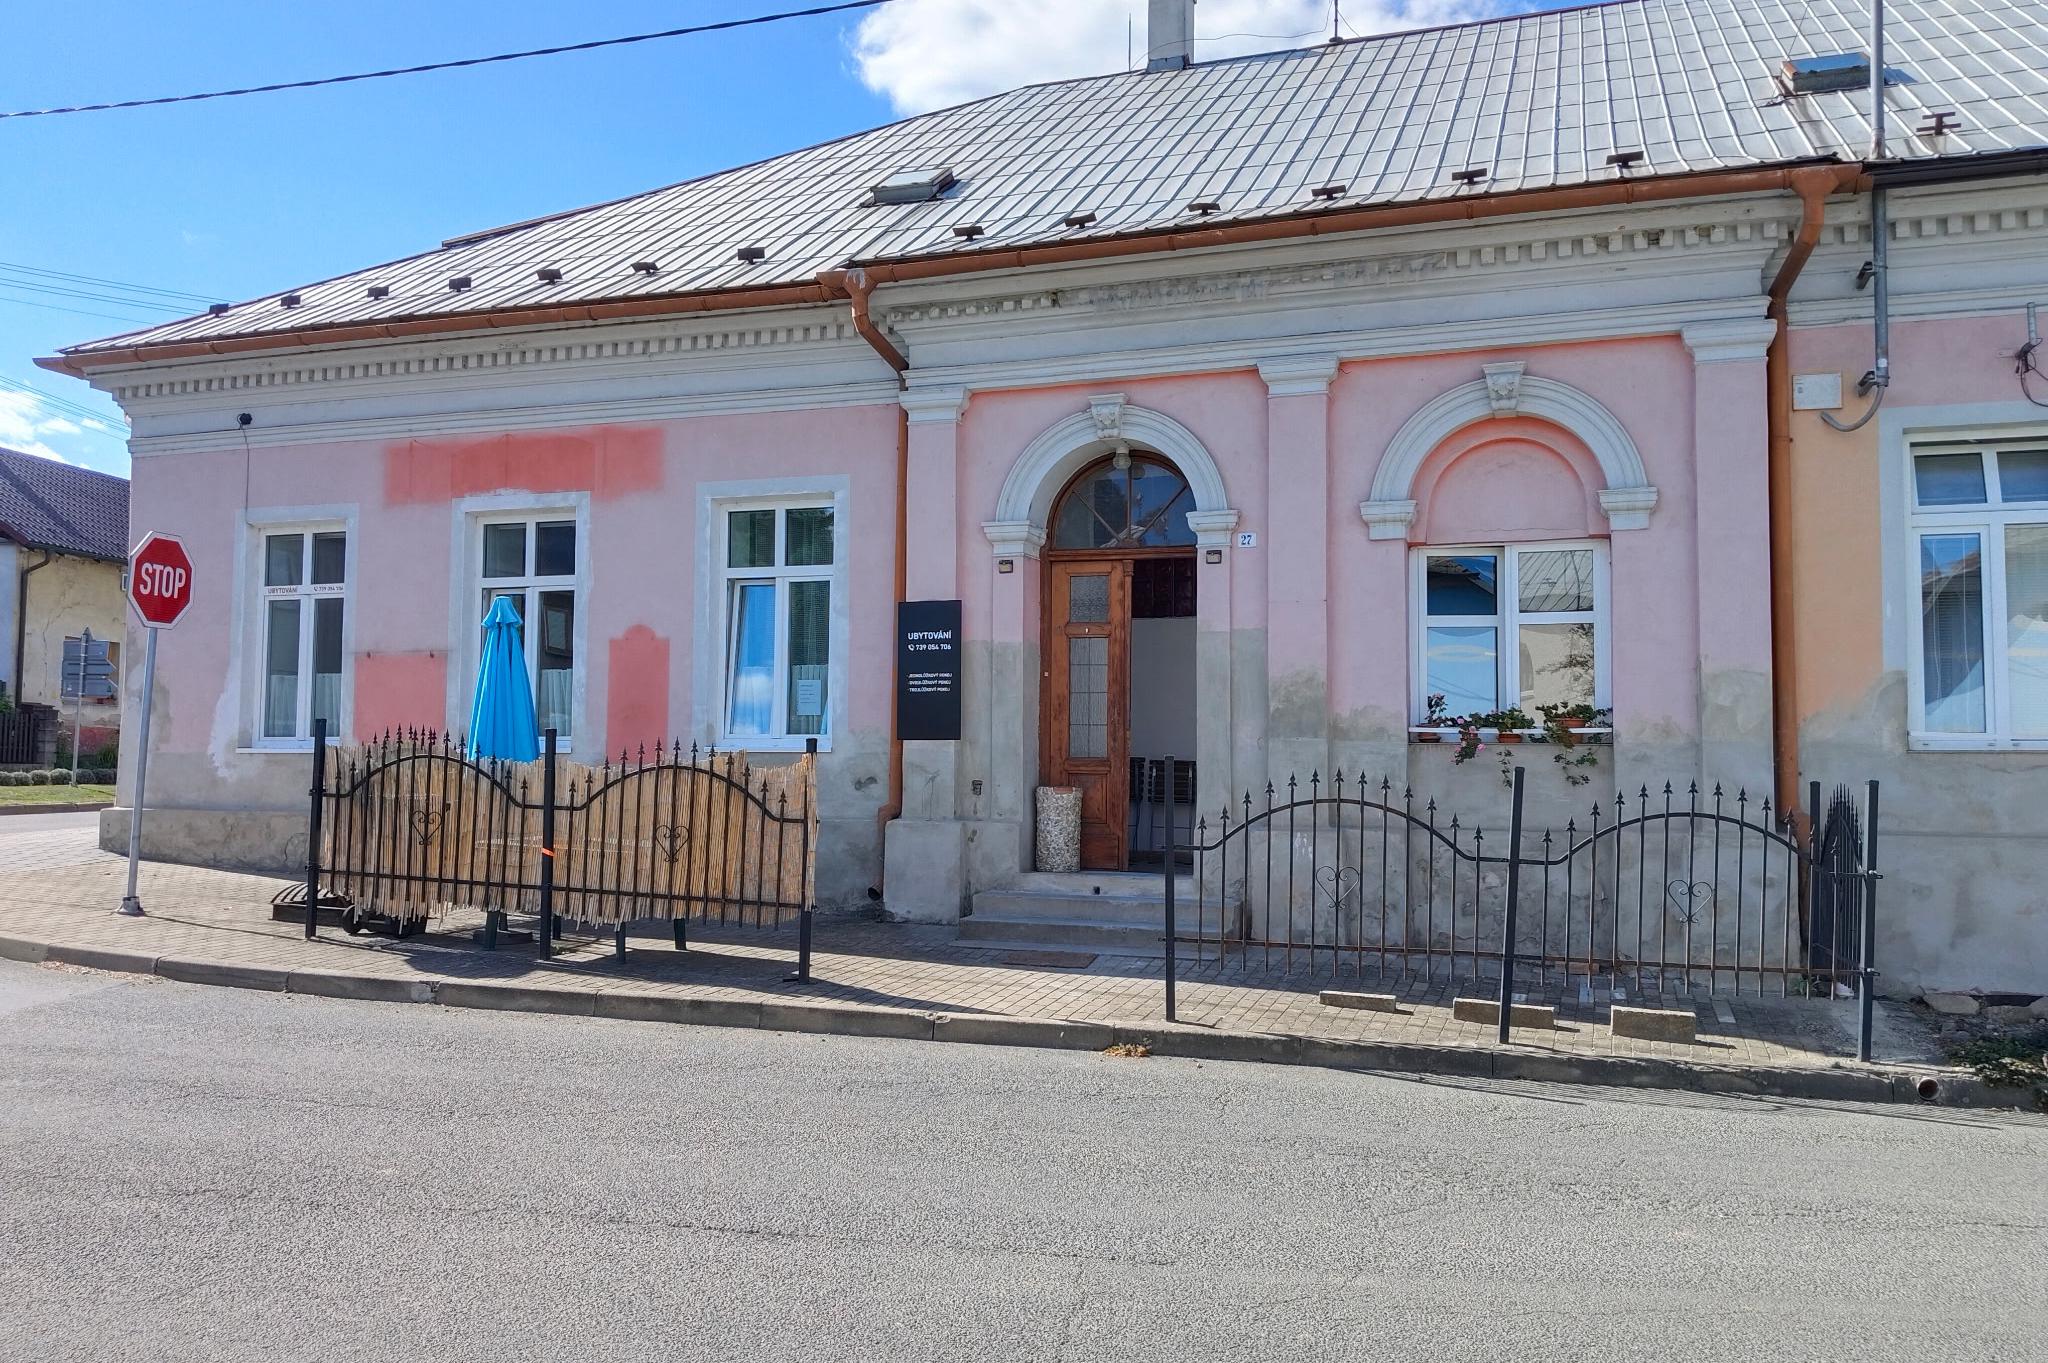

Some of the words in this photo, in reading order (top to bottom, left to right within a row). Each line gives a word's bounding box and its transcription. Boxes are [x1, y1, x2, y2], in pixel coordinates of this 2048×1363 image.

[1240, 534, 1252, 545] 27
[139, 562, 187, 599] STOP
[907, 630, 952, 640] UBYTOVÁNÍ
